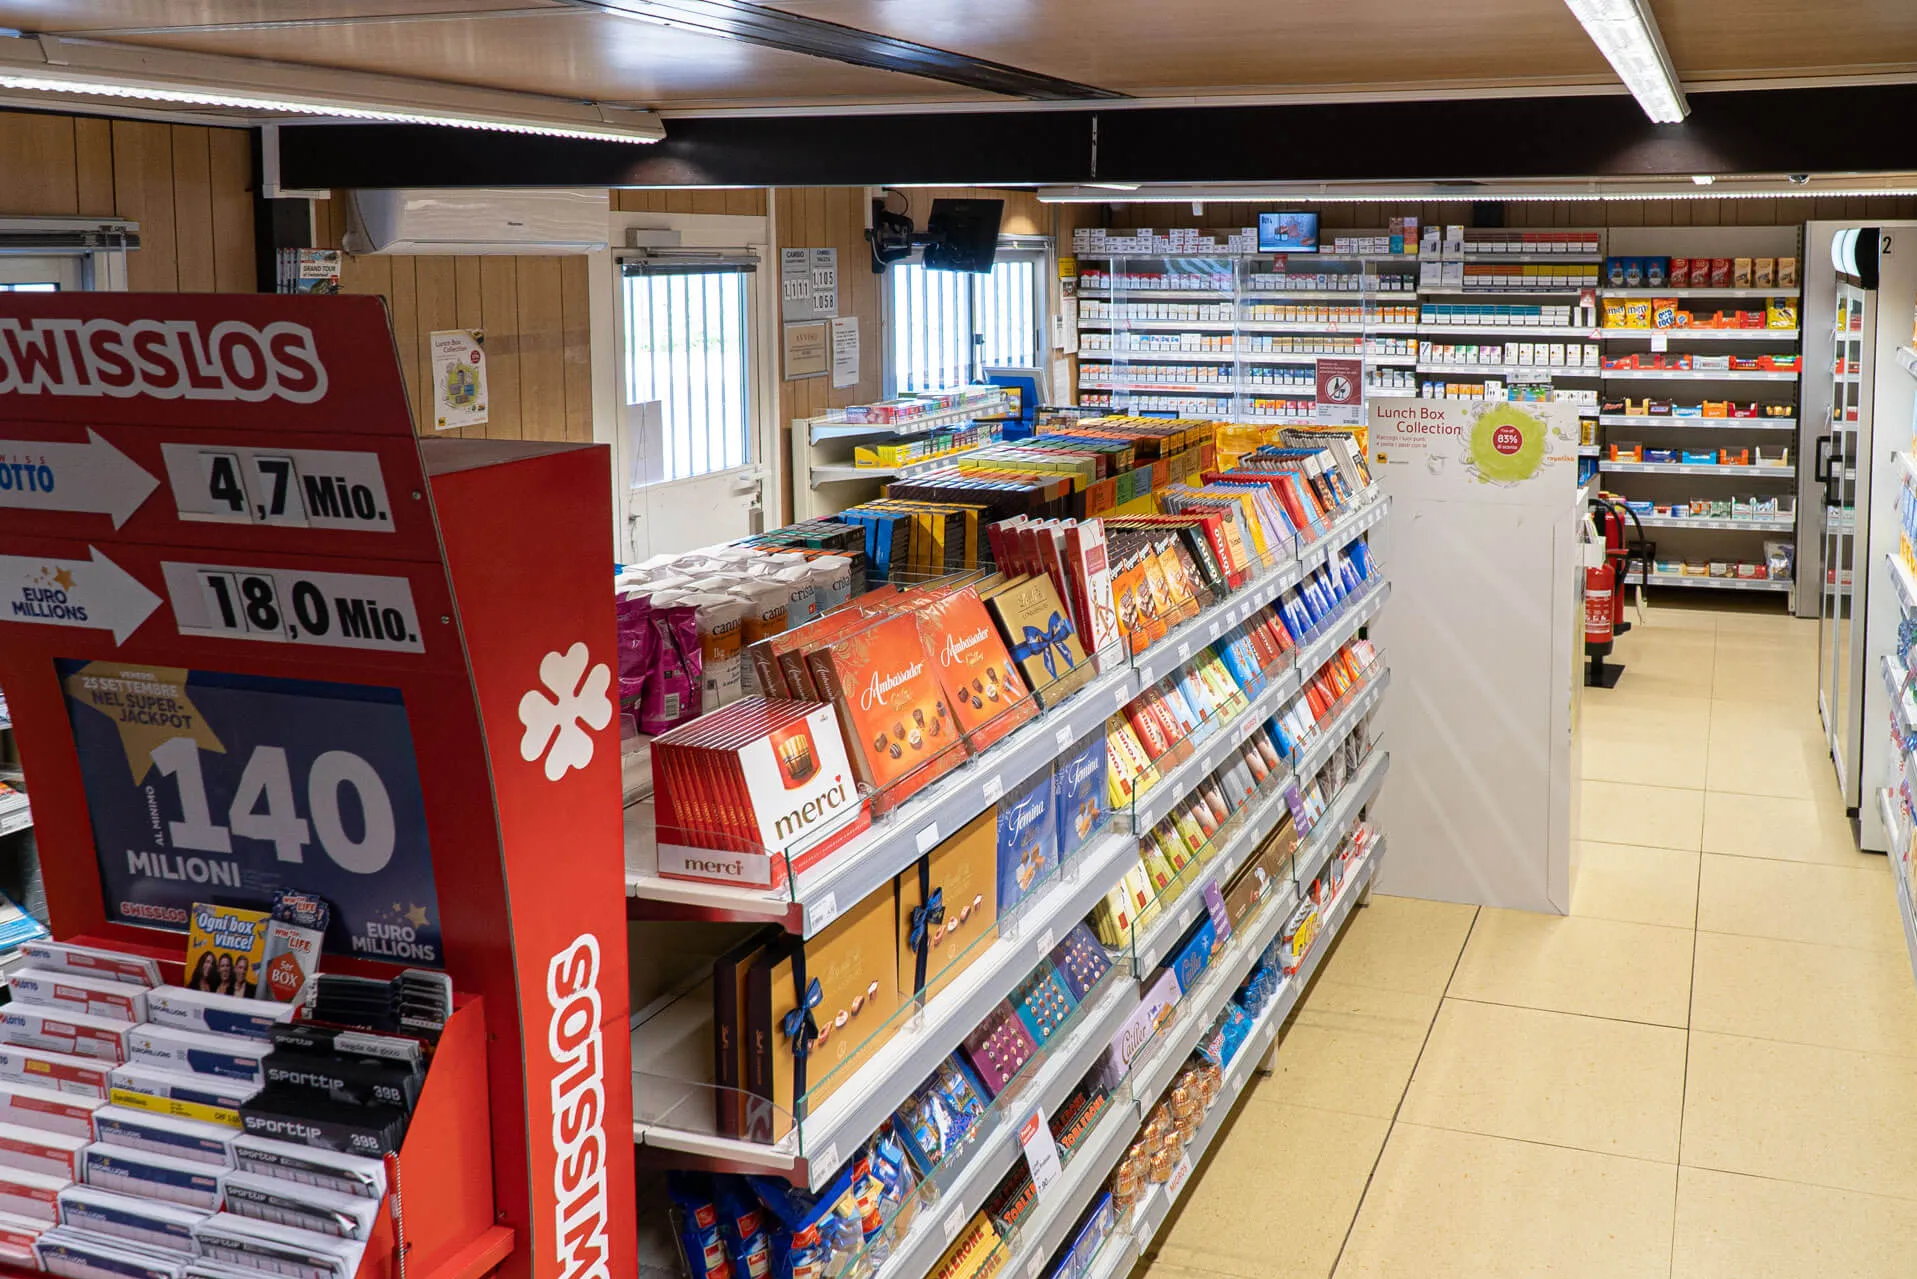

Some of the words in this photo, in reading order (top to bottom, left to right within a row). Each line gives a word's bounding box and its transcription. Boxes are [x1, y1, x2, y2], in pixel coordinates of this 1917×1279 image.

[1882, 236, 1892, 254] 2
[0, 319, 328, 403] WISSLOS
[1376, 406, 1416, 420] Lunch
[1420, 407, 1445, 420] Box
[1396, 421, 1461, 436] Collection
[209, 456, 290, 521] 4,7
[303, 474, 388, 521] Mio.
[22, 586, 67, 604] EURO
[12, 601, 89, 622] MILLIONS
[208, 574, 330, 640] 18,0
[334, 597, 418, 643] Mio.
[940, 627, 989, 668] Ambassador
[100, 677, 179, 697] SETTEMBRE
[860, 659, 924, 712] Ambassador
[91, 691, 125, 707] NEL
[119, 708, 192, 729] JACKPOT
[1067, 753, 1099, 799] Femina
[150, 736, 396, 874] 140
[774, 777, 847, 842] merci
[1008, 795, 1045, 847] Femina
[126, 850, 241, 888] MILIONI
[684, 860, 744, 876] merci
[119, 902, 188, 924] SWISSLOS
[198, 913, 228, 932] Ogni
[230, 916, 255, 934] box
[215, 932, 254, 951] vince!
[366, 920, 416, 942] EURO
[288, 937, 313, 952] LIFE
[351, 935, 436, 961] MILLIONS
[280, 960, 294, 970] 5er
[271, 968, 299, 988] BOX
[1121, 1022, 1147, 1065] Cailler
[547, 933, 609, 1279] WISSLOS
